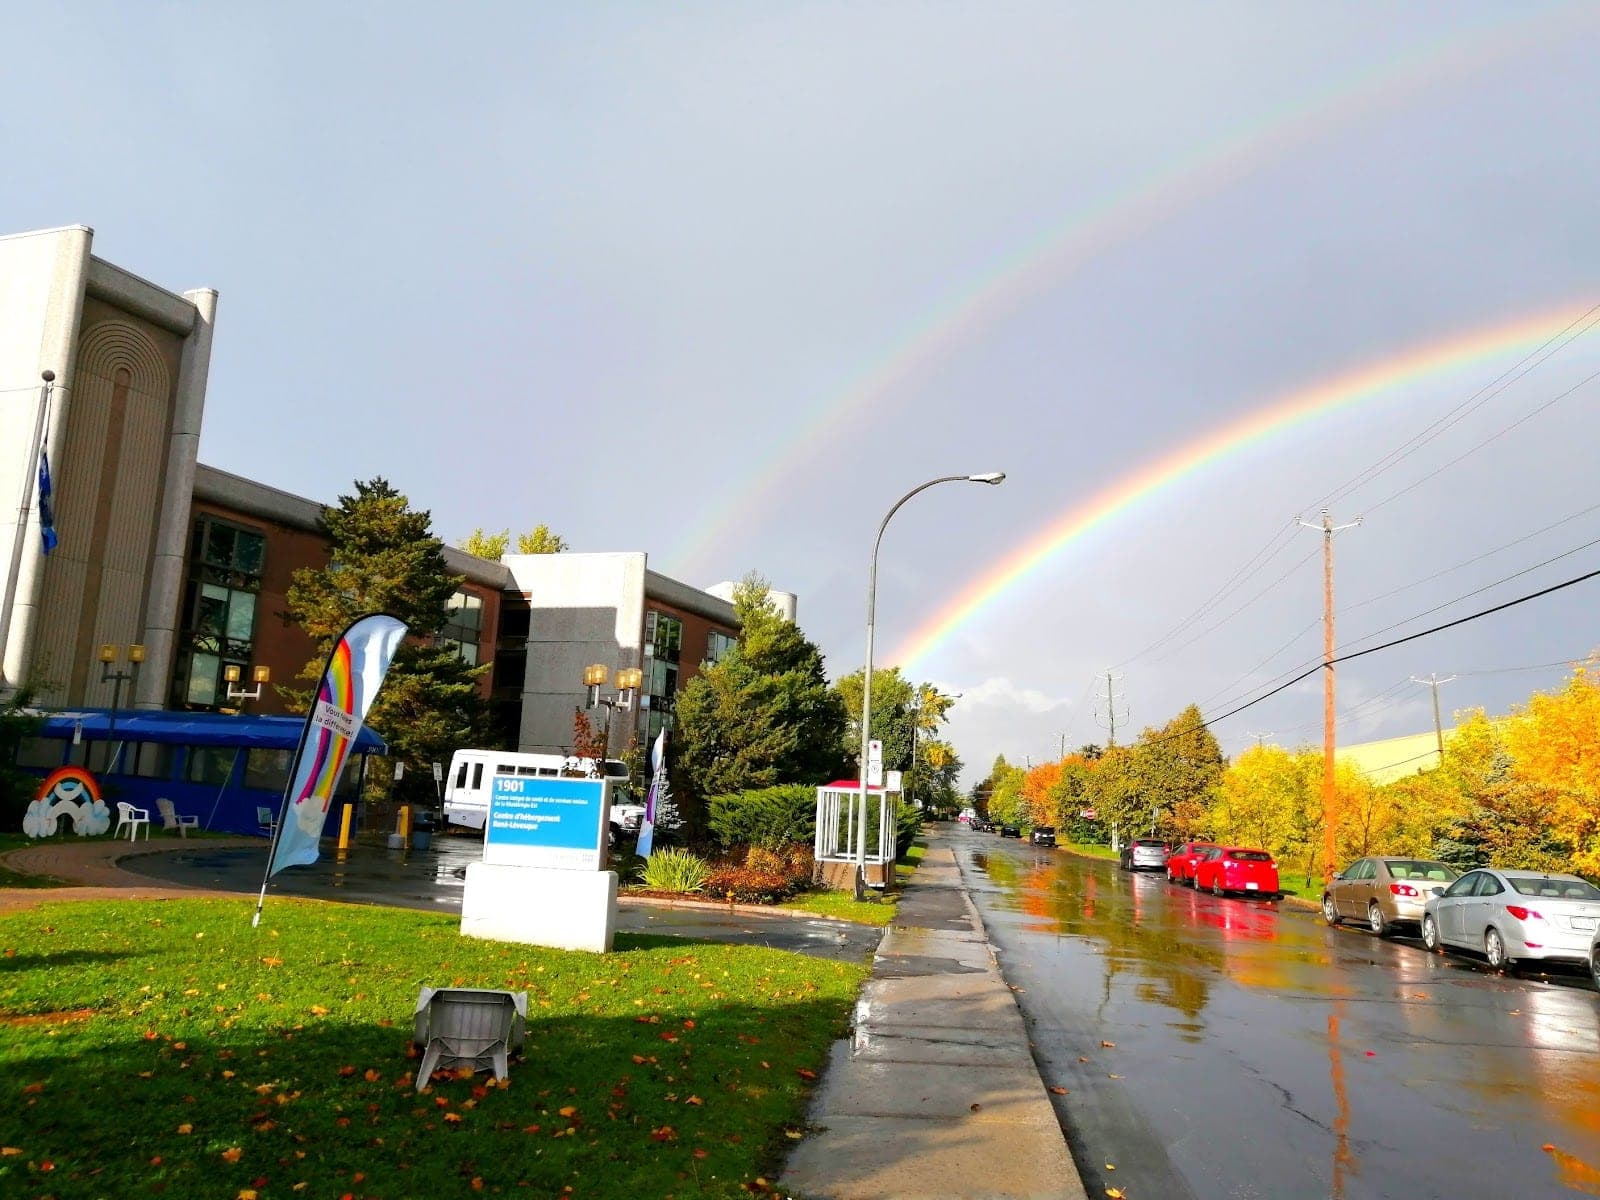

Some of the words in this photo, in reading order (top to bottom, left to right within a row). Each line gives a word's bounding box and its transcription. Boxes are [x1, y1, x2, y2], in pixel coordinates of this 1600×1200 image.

[325, 705, 340, 717] Vous
[497, 780, 524, 792] 1901
[493, 812, 513, 820] Centre
[514, 812, 561, 823] d'hébergement
